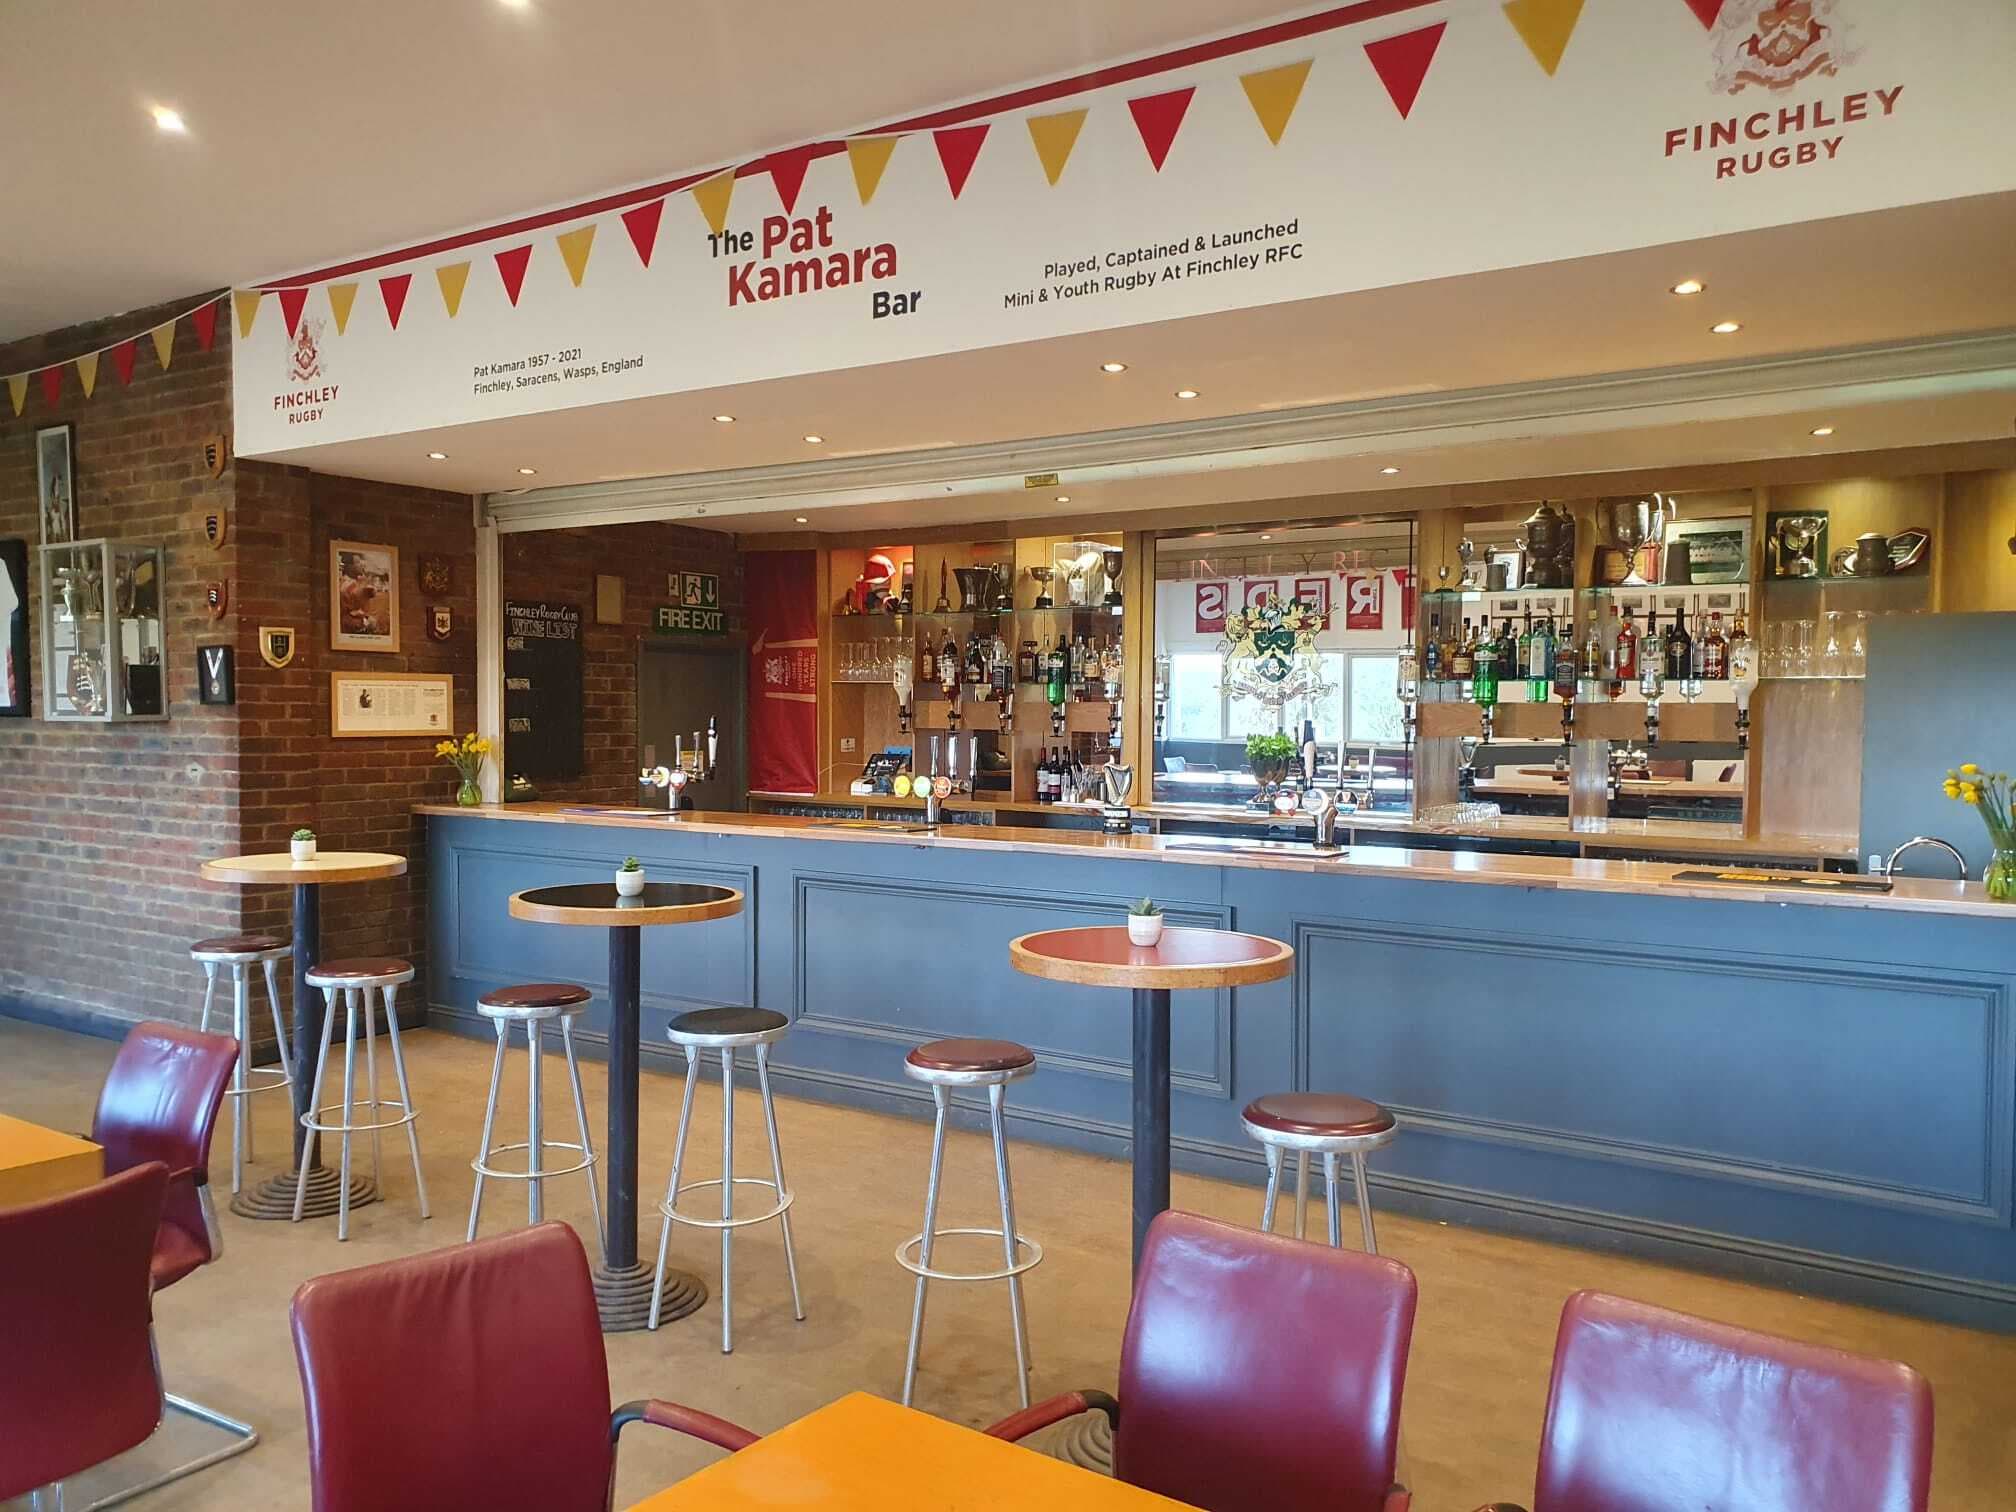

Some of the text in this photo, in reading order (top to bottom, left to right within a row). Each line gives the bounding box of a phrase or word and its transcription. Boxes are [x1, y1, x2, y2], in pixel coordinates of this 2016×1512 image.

[1664, 85, 1904, 157] FINCHLEY
[1716, 135, 1844, 179] RUGBY
[708, 205, 833, 260] The Pat
[1044, 218, 1299, 279] Played, Captained & Launched
[729, 243, 897, 307] Kamara
[1004, 243, 1303, 309] Mini & Youth Rugby At Finchley RFC
[872, 290, 922, 319] Bar
[474, 364, 489, 378] Pat
[491, 360, 526, 374] Kamara
[528, 354, 550, 368] 1957
[558, 348, 582, 363] 2021
[474, 354, 644, 395] Finchley, Saracens, Wasps, England
[274, 385, 339, 410] FINCHLEY
[289, 408, 324, 424] RUGBY
[659, 607, 724, 632] FIRE EXIT
